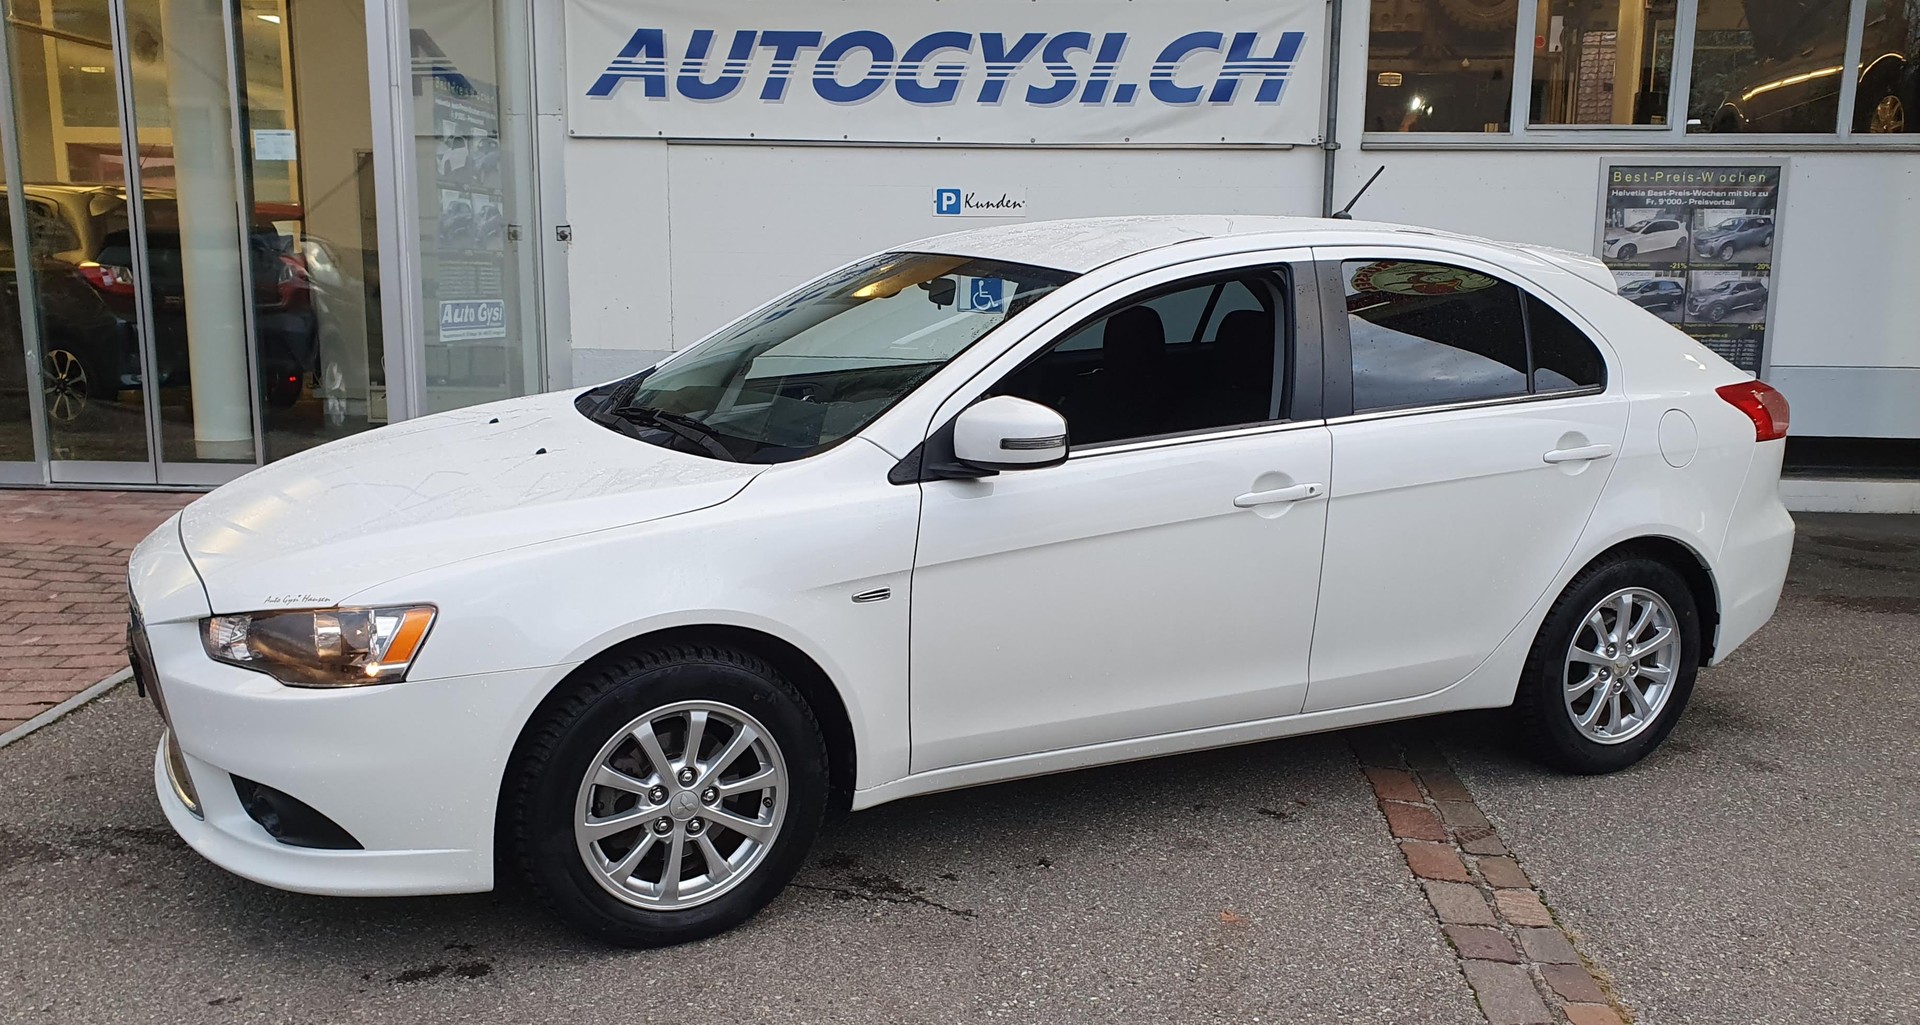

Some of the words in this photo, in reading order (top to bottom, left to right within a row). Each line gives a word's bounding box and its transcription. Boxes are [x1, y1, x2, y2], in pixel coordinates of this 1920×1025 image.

[586, 28, 1306, 106] AUTOGYSI.CH
[942, 192, 956, 211] P
[965, 192, 1023, 210] Kunden
[1647, 190, 1726, 198] Best-Preis-Wochen
[1688, 198, 1735, 206] Preisvorteil
[442, 304, 475, 324] Auto
[477, 303, 503, 326] Gysi
